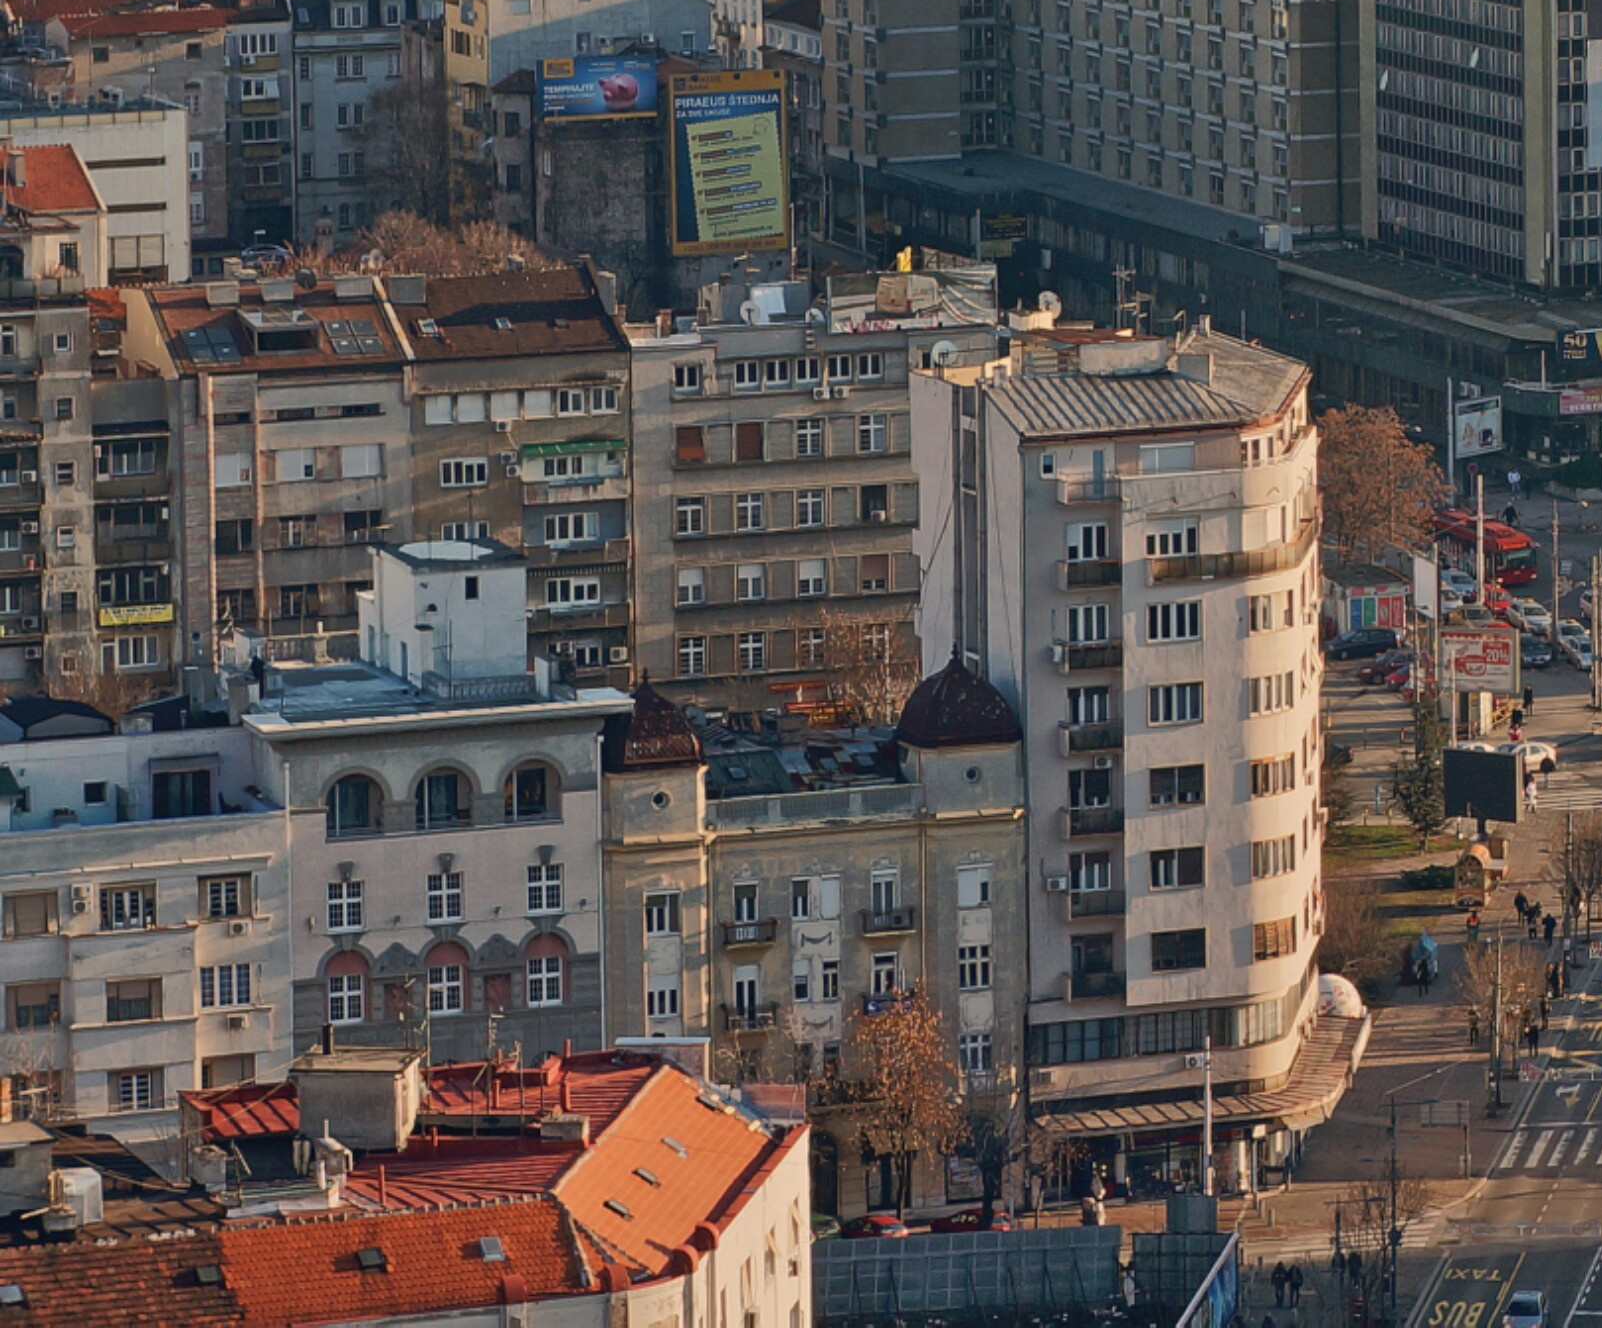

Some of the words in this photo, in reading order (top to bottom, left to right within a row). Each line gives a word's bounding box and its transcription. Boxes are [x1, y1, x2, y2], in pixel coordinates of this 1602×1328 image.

[674, 95, 726, 109] PIRAEUS
[728, 93, 779, 107] ŠTEDNJA
[1563, 332, 1588, 347] 50
[1444, 1268, 1501, 1281] TAXI
[1428, 1300, 1487, 1328] BUS
